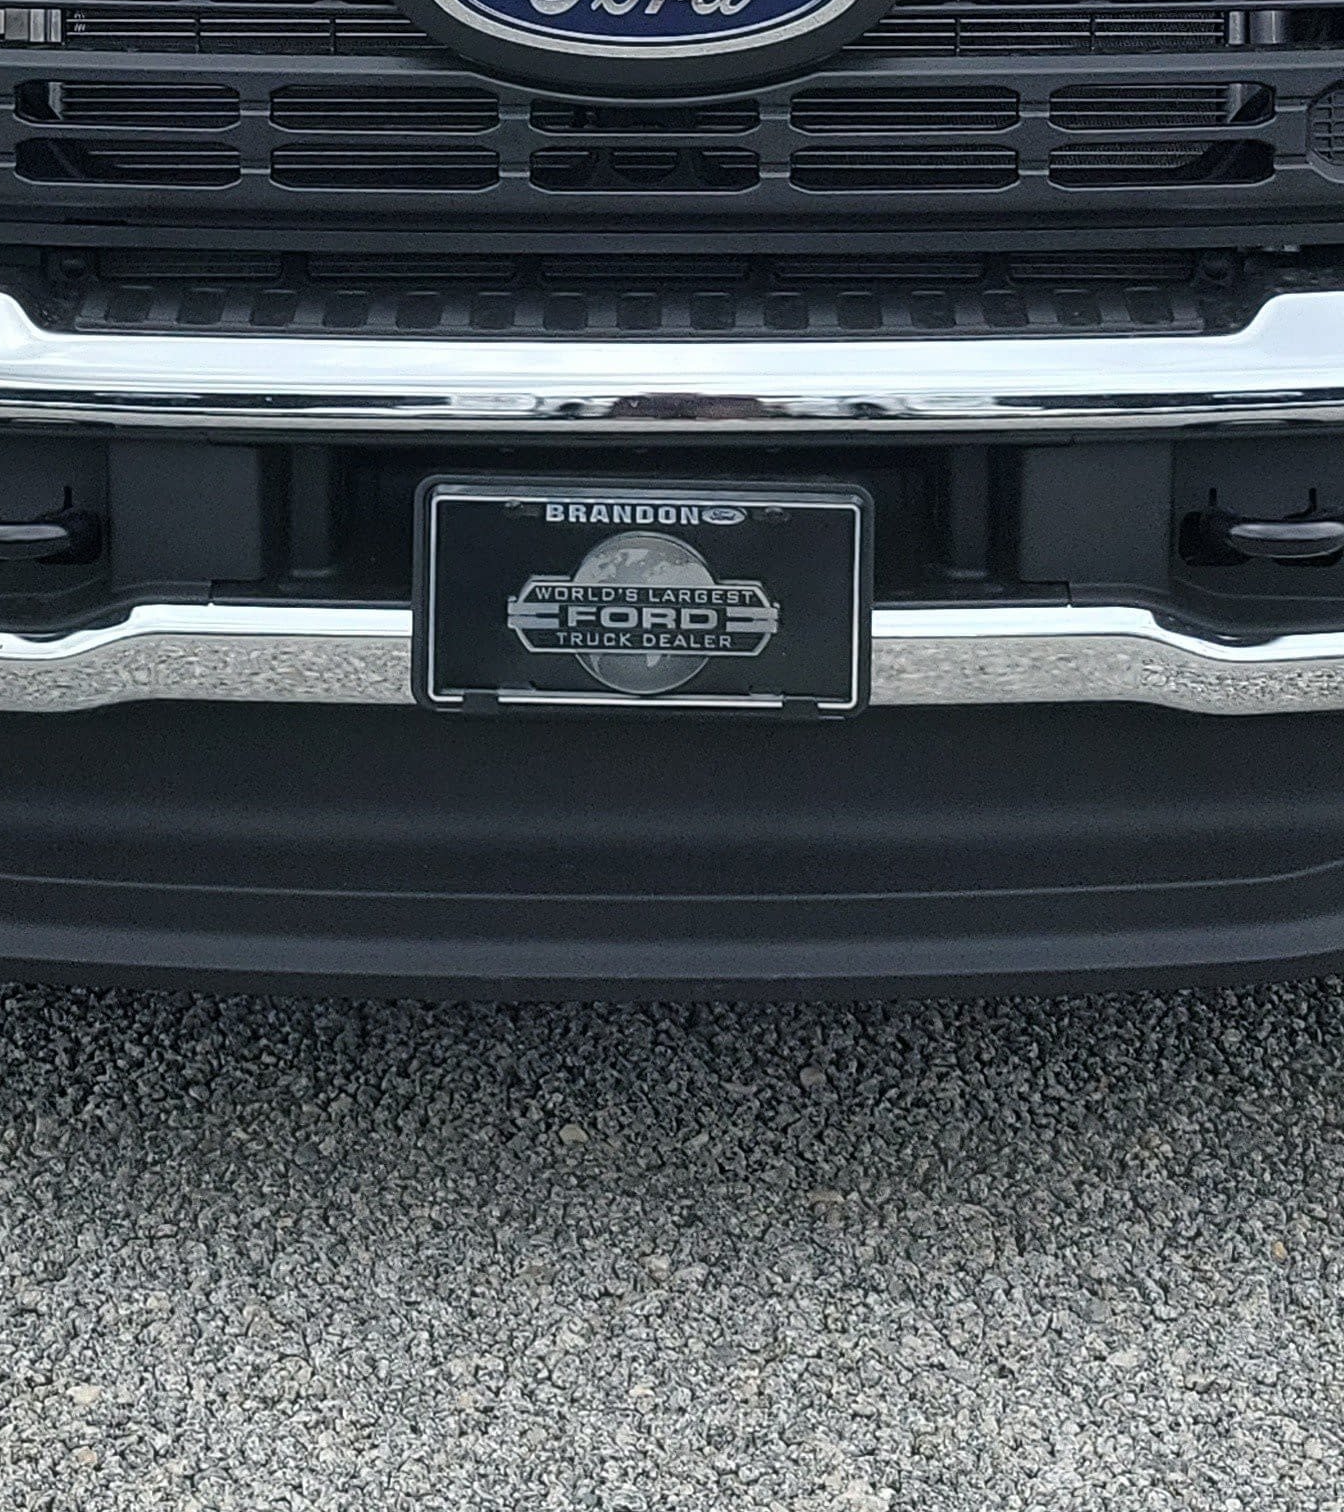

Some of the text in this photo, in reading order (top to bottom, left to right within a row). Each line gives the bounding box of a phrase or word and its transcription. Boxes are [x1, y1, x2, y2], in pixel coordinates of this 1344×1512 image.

[545, 503, 700, 525] BRANDON
[536, 586, 756, 605] WORLD'S LARGEST
[567, 606, 718, 630] FORD
[556, 632, 732, 649] TRUCK DEALER
